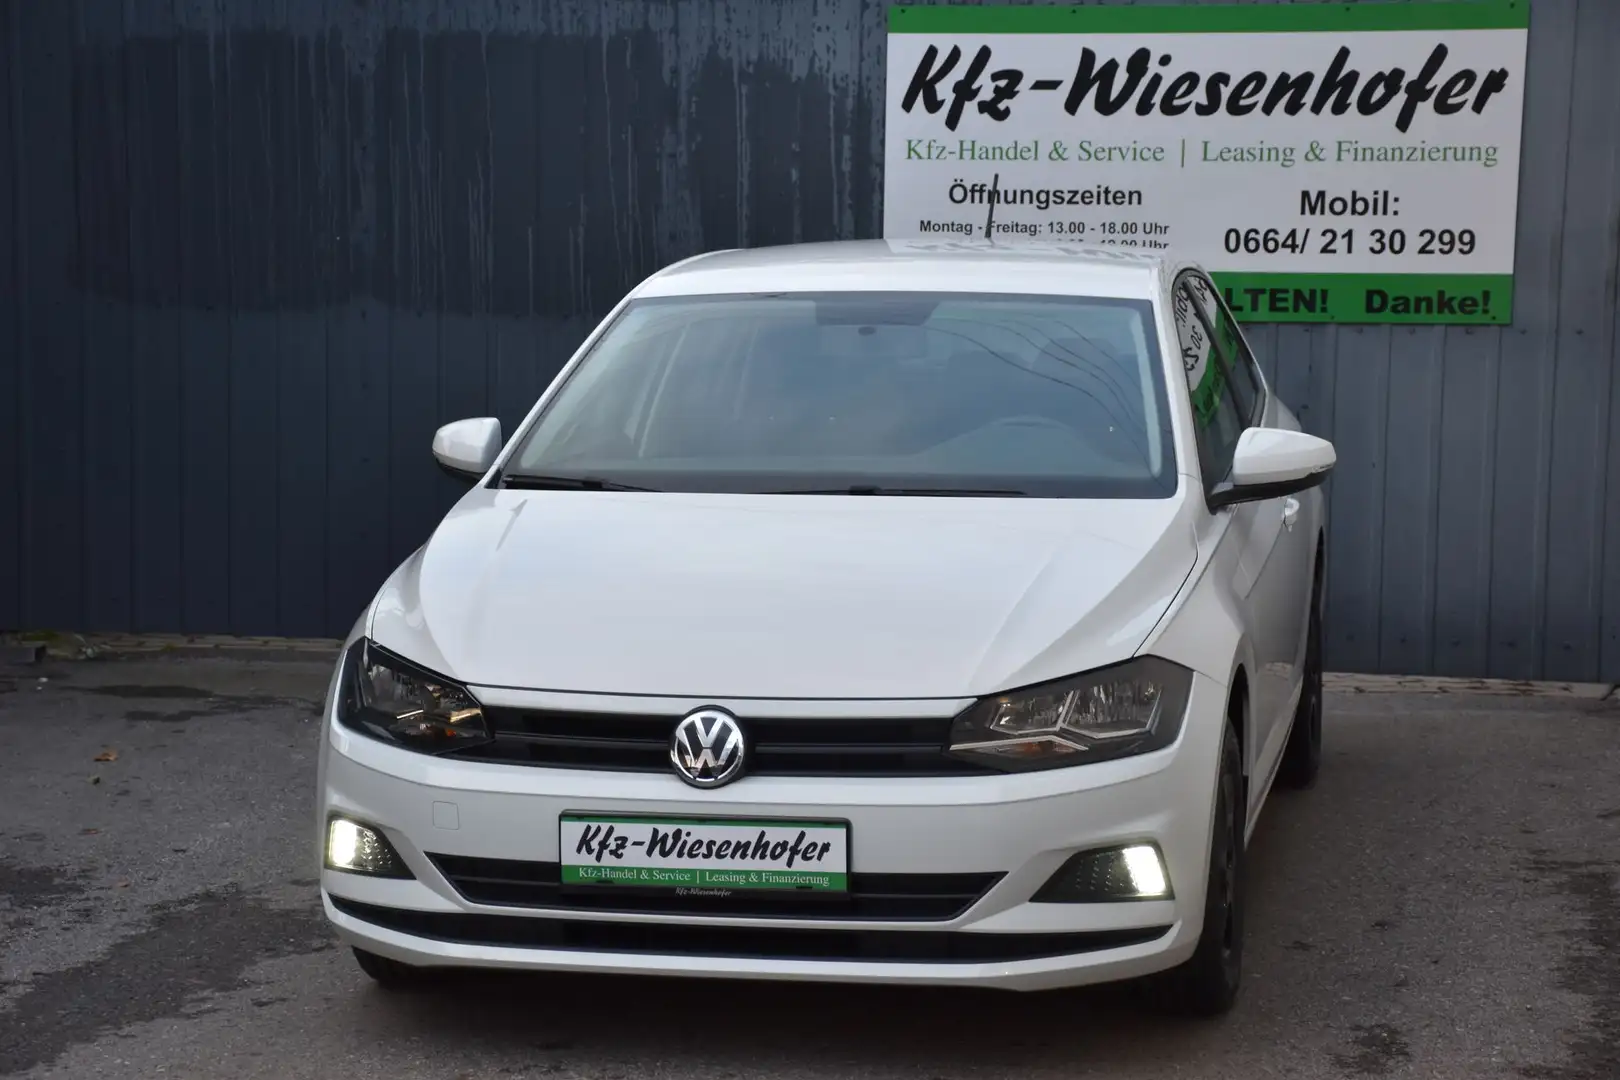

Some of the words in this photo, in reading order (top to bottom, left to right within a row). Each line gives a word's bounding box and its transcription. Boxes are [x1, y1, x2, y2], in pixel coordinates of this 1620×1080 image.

[901, 43, 1509, 133] Kfz-Wiesenhofer
[905, 139, 1039, 161] Kfz-Handel
[1048, 140, 1069, 162] &
[1078, 140, 1165, 162] Service
[1202, 140, 1296, 168] Leasing
[1304, 140, 1326, 163] &
[1335, 140, 1499, 168] Finanzierung
[949, 179, 1143, 210] Öffnungszeiten
[1300, 190, 1400, 216] Mobil:
[919, 220, 974, 236] Montag
[1047, 222, 1086, 234] 13.00
[1100, 223, 1138, 235] 18.00
[1143, 223, 1170, 236] Uhr
[1224, 228, 1310, 254] 0664/
[1320, 229, 1354, 255] 21
[1369, 229, 1406, 255] 30
[1417, 229, 1476, 255] 299
[1364, 290, 1492, 315] Danke!
[576, 824, 832, 869] Kfz-Wiesenhofer
[578, 867, 637, 880] Kfz-Handel
[640, 869, 649, 880] &
[653, 869, 691, 882] Service
[706, 871, 746, 885] Leasing
[750, 873, 759, 884] &
[762, 873, 830, 886] Finanzierung
